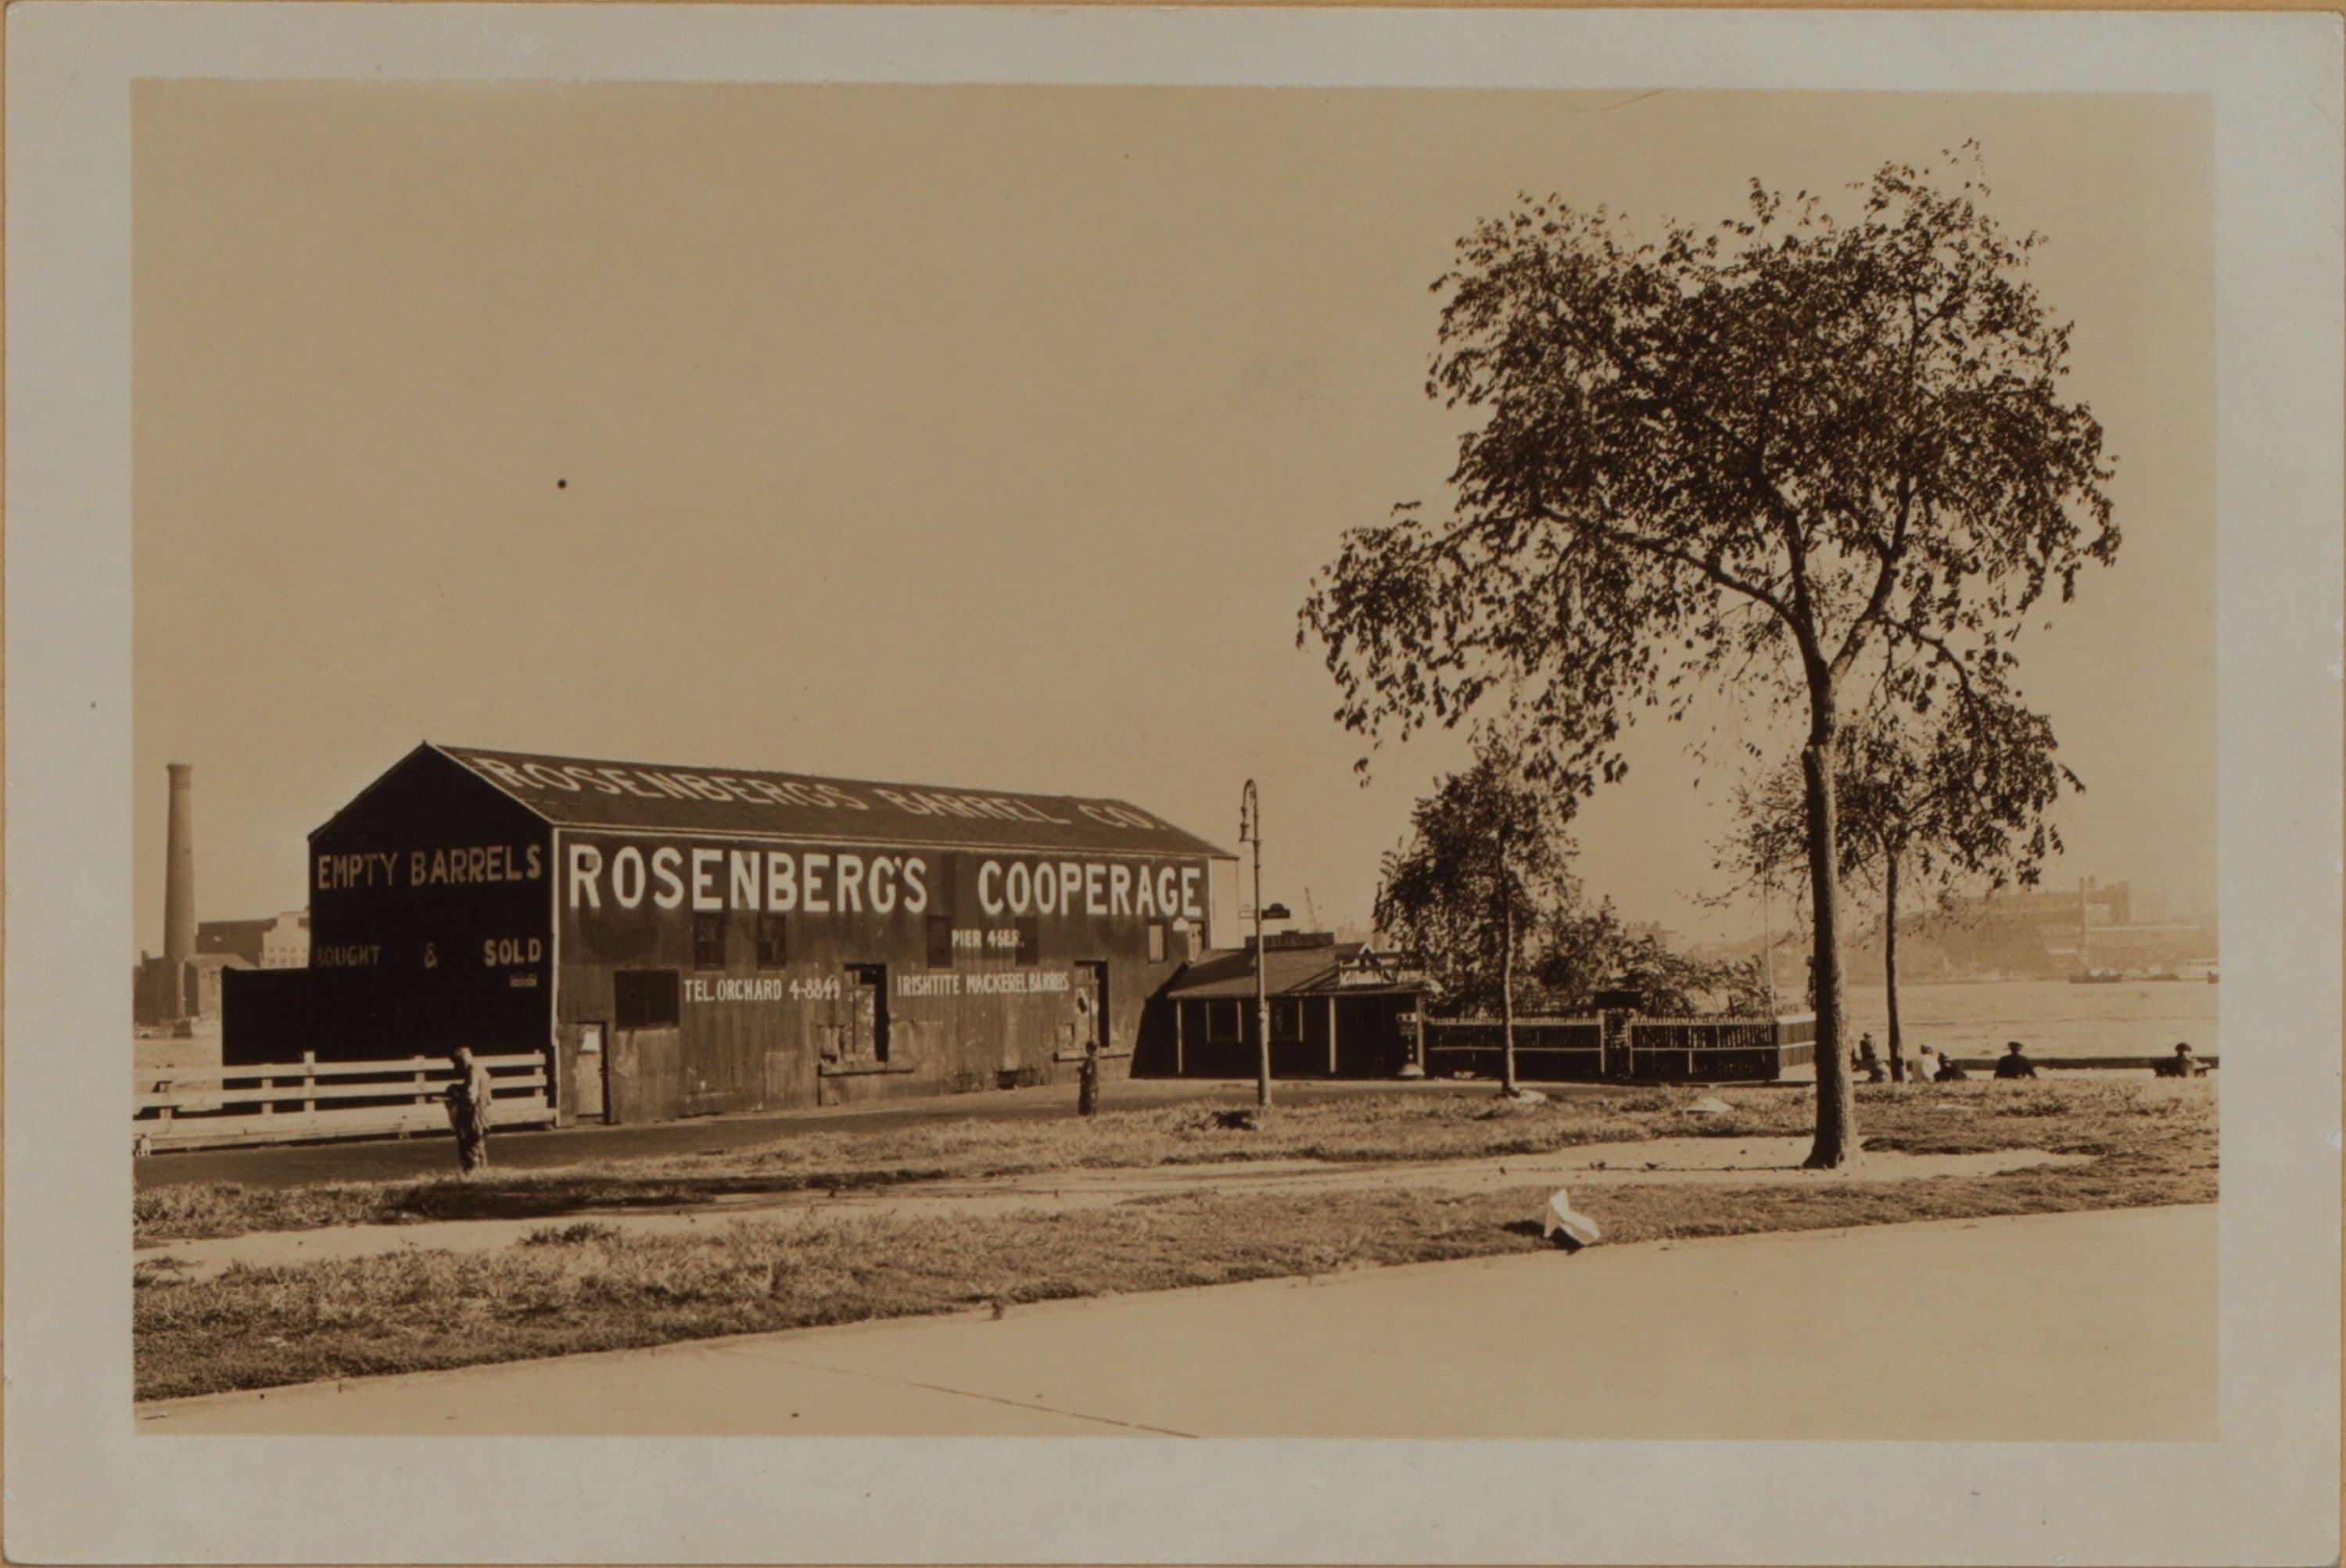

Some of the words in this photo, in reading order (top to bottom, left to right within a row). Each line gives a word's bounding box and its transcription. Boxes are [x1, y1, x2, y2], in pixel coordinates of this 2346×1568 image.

[872, 788, 1071, 824] BARREL
[317, 852, 398, 889] EMPTY
[411, 844, 542, 885] BARRELS
[569, 844, 927, 914] ROSENBERG'S
[978, 860, 1202, 917] COOPERAGE
[424, 942, 438, 969] &
[484, 938, 541, 967] SOLD
[951, 928, 982, 948] PIER
[716, 979, 782, 1001] ORCHARD
[897, 974, 960, 996] IRISHTITE
[966, 972, 1028, 993] MACKEREL
